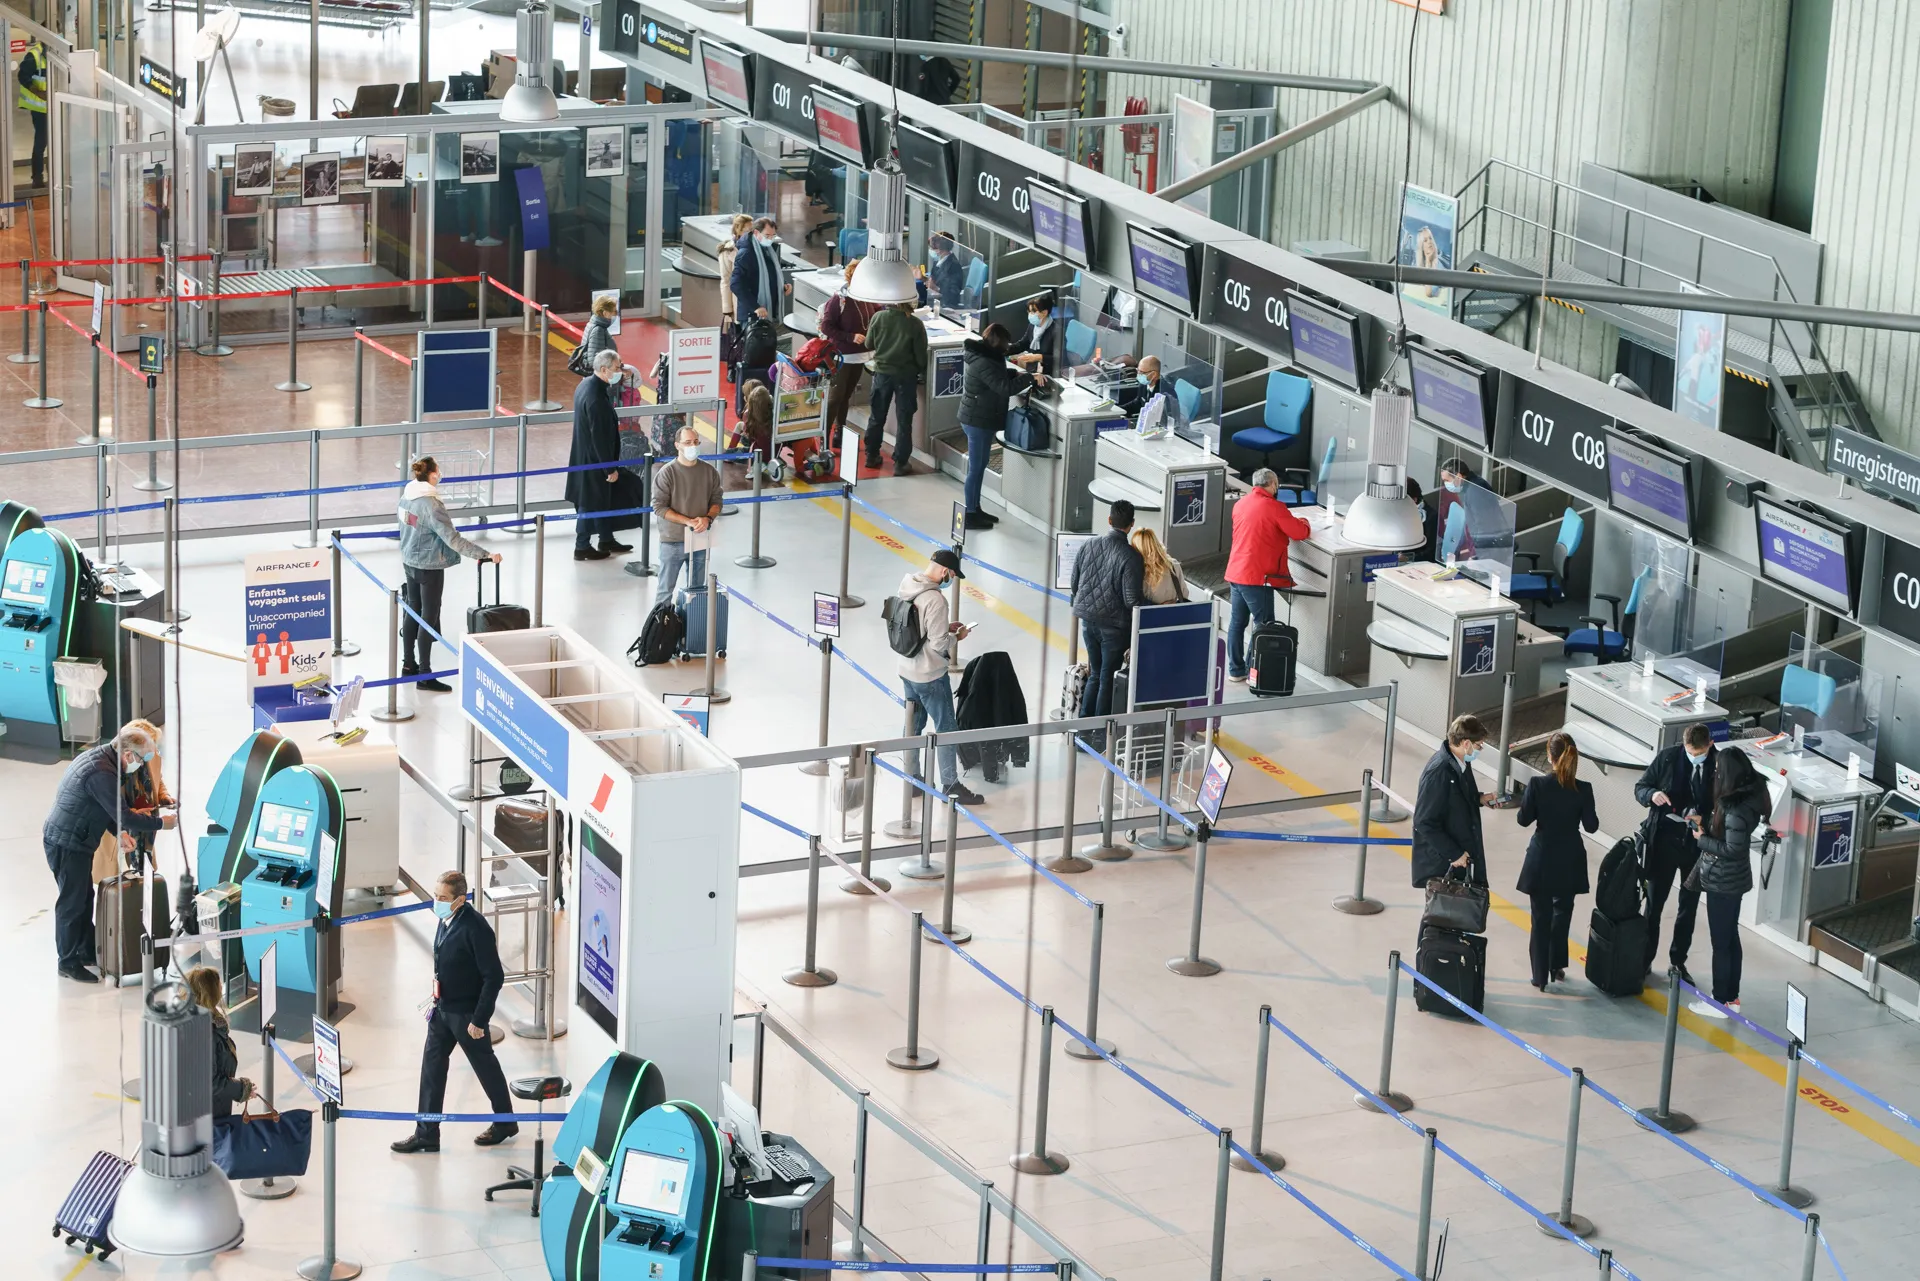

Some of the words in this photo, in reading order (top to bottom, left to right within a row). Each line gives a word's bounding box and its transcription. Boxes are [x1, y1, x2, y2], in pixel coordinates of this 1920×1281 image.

[584, 17, 590, 35] 2
[772, 82, 790, 110] C01
[801, 94, 814, 120] C0
[526, 198, 540, 206] Sortie
[978, 172, 1000, 201] C03
[1012, 186, 1030, 214] C0
[1406, 191, 1446, 211] AIRFRANCE
[1224, 278, 1251, 312] C05
[679, 336, 712, 348] SORTIE
[683, 384, 706, 394] EXIT
[1522, 410, 1554, 446] C07
[1572, 432, 1605, 470] C08
[1612, 445, 1644, 464] AIRFRANCE
[1765, 512, 1800, 532] AIRFRANCE
[876, 535, 904, 550] STOP
[256, 562, 310, 572] AIRFRANCE
[248, 588, 286, 598] Enfants
[248, 595, 299, 608] voyageant
[302, 592, 326, 602] seuls
[248, 608, 325, 622] Unaccompanied
[249, 622, 276, 630] minor
[292, 656, 316, 666] Kids
[297, 664, 318, 673] Solo
[476, 667, 514, 710] BIENVENUE
[1248, 756, 1284, 774] STOP
[584, 809, 610, 836] AIRFRANCE
[318, 1046, 324, 1064] 2
[1800, 1088, 1850, 1113] STOP
